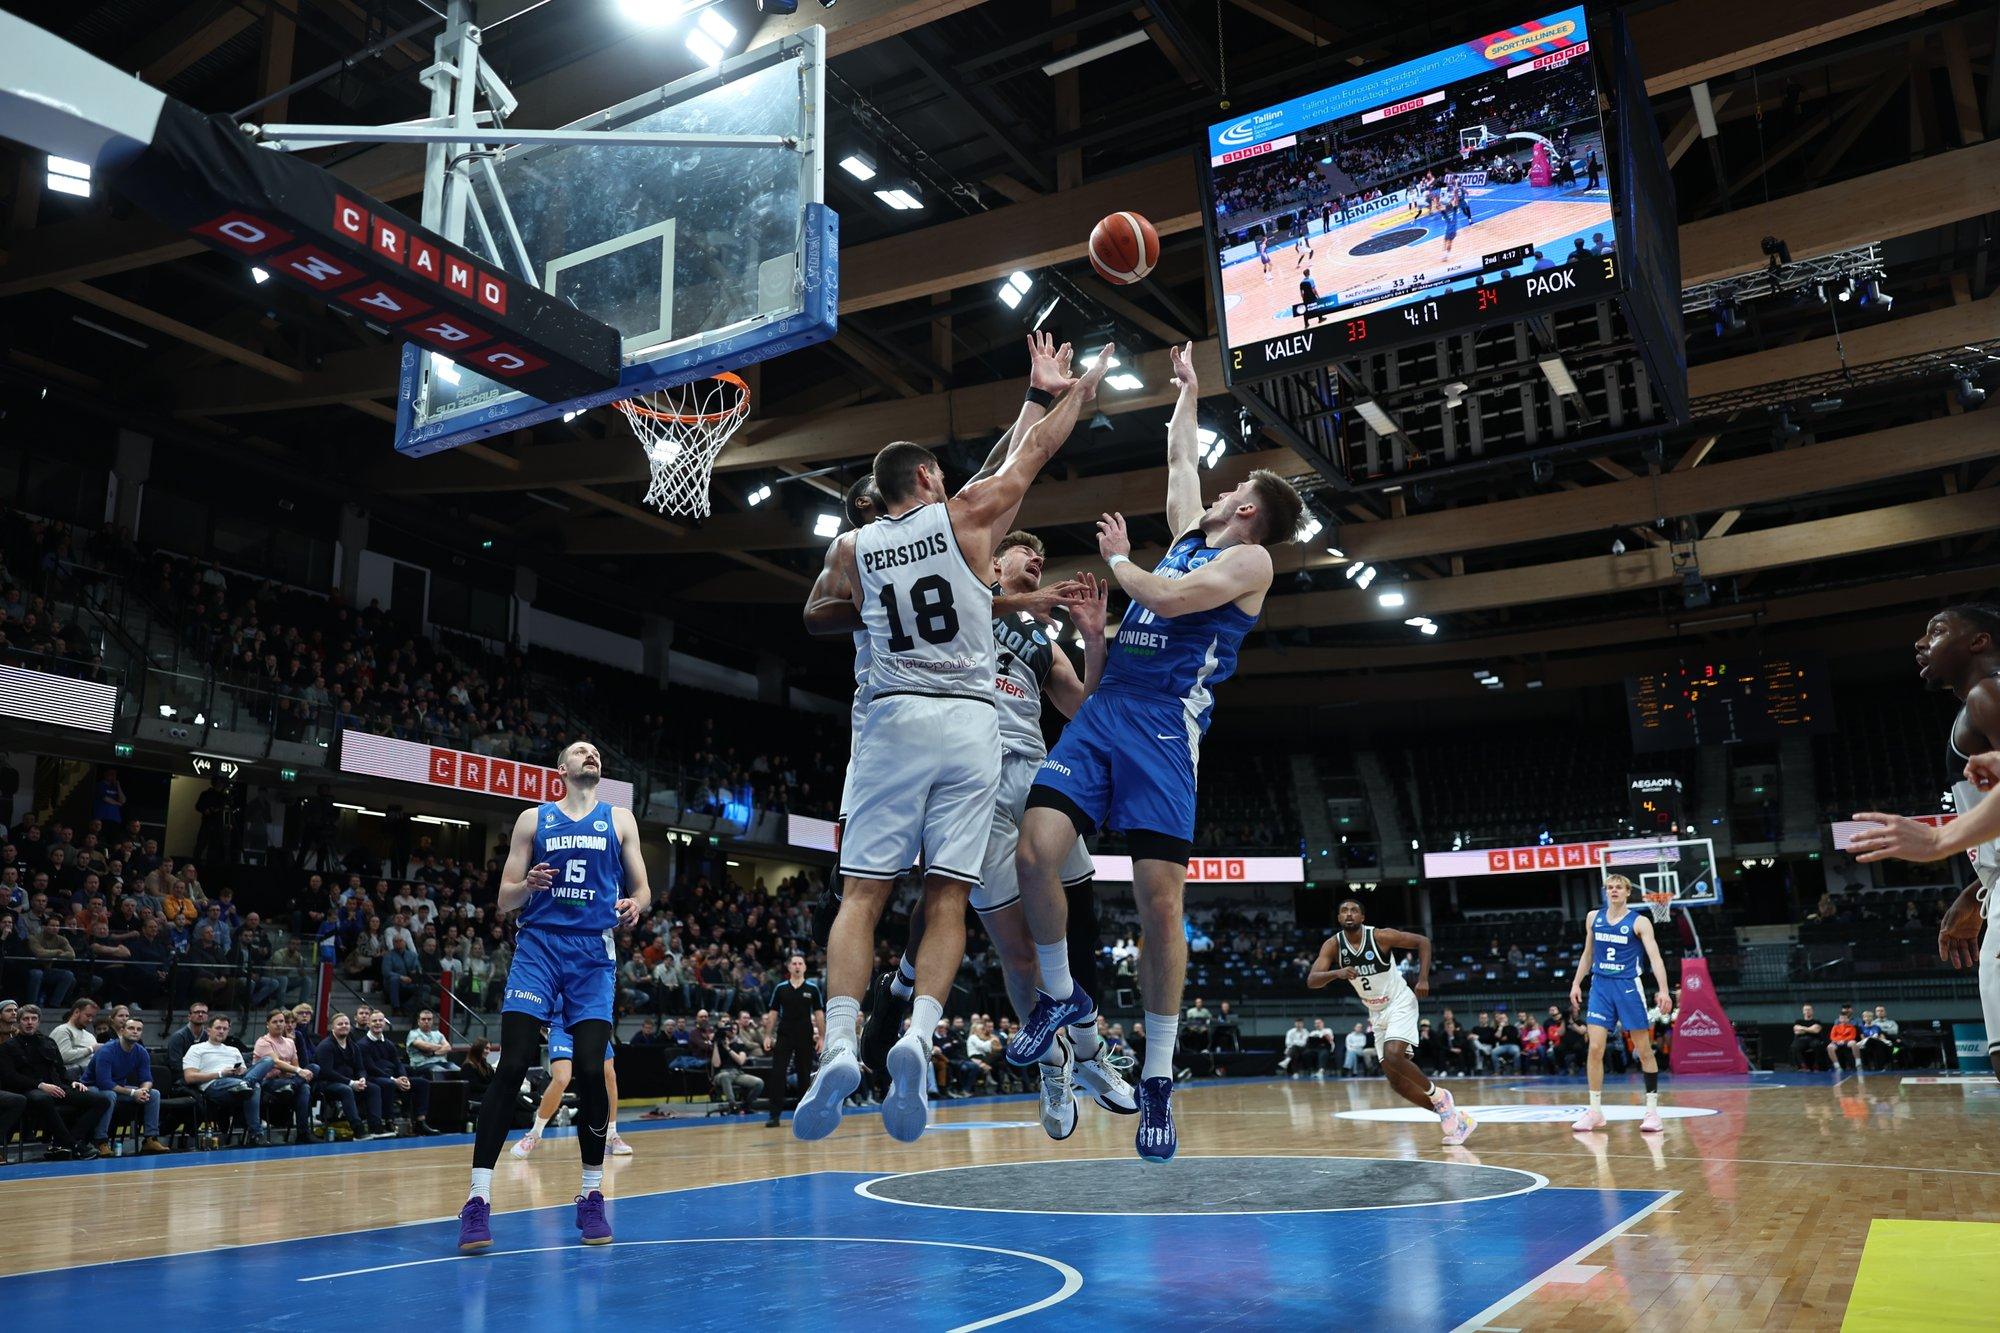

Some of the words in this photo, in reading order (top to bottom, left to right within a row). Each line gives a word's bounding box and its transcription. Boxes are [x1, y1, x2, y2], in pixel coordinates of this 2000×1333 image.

[1535, 46, 1584, 67] CRAMO
[1253, 109, 1284, 125] Tallinn
[1225, 145, 1270, 162] CRAMO
[343, 208, 500, 304] CRAMO
[1603, 259, 1614, 279] 3
[218, 221, 525, 370] CRAMO
[1233, 350, 1242, 369] 2
[1265, 333, 1314, 361] KALEV
[1347, 320, 1366, 342] 33
[1404, 302, 1438, 327] 4:17
[1478, 288, 1497, 311] 34
[1526, 269, 1576, 298] PAOK
[863, 532, 948, 574] PERSIDIS
[878, 573, 960, 653] 18
[1119, 630, 1168, 649] UNIBET
[197, 759, 211, 770] A4
[220, 762, 232, 772] B1
[1042, 759, 1071, 777] allinn
[436, 757, 566, 798] CRAMO
[545, 835, 607, 852] KALEV/CRAMO
[565, 859, 587, 884] 15
[1186, 862, 1241, 877] AMO
[551, 887, 596, 901] UNIBET
[1606, 947, 1616, 961] 2
[1354, 963, 1377, 976] AOK
[1360, 977, 1372, 992] 2
[514, 989, 543, 1005] Tallinn
